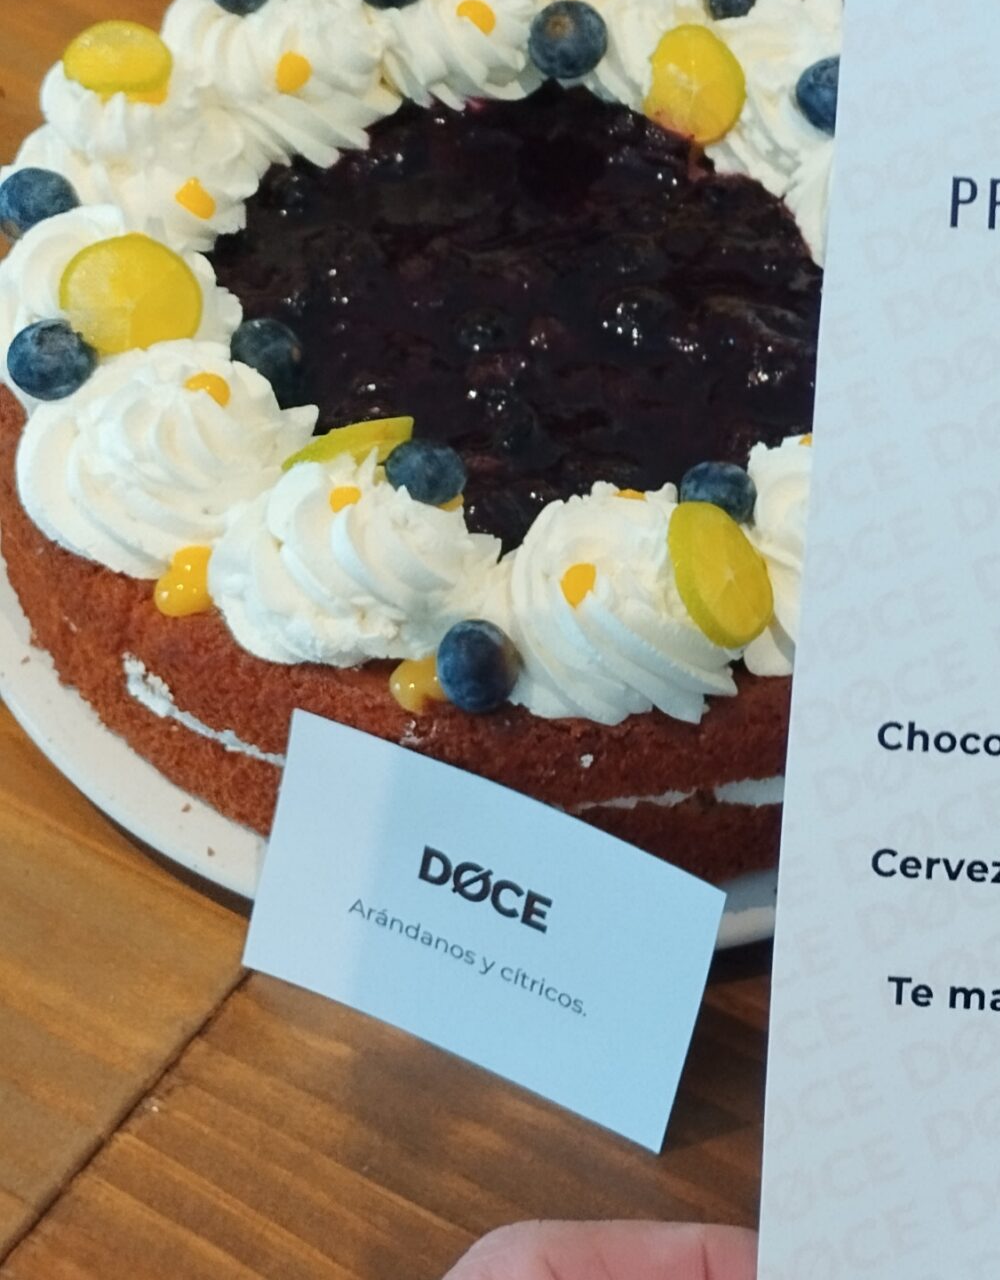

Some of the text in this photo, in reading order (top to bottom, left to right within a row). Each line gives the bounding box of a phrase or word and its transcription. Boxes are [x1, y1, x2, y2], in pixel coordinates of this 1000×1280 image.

[347, 897, 588, 1018] Arándanos y cítricos.
[887, 975, 934, 1008] Te
